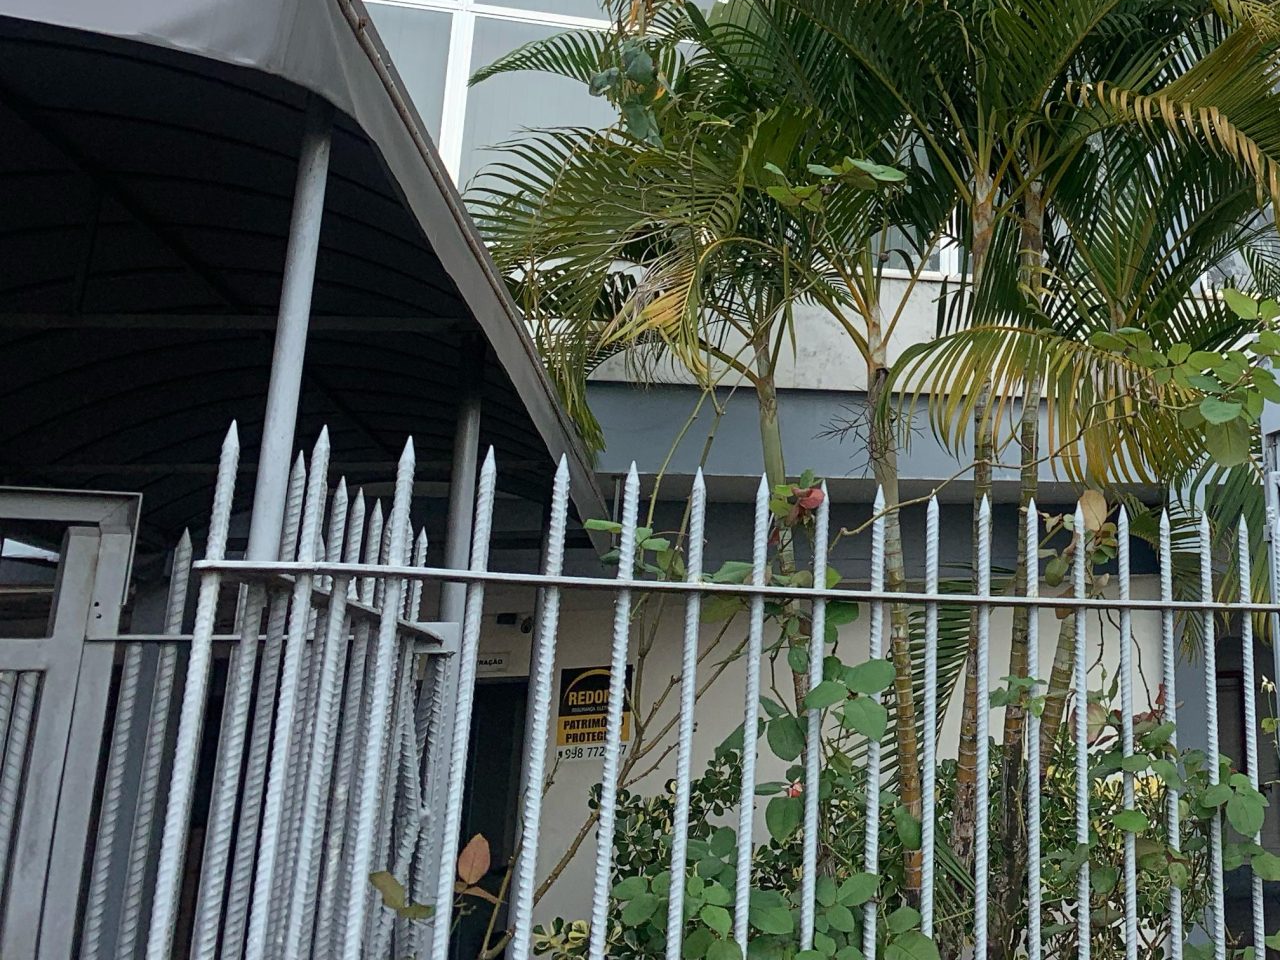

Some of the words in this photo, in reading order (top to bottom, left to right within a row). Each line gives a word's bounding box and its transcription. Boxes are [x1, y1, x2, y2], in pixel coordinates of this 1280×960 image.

[568, 689, 611, 706] REDO
[563, 715, 625, 730] PATRIMÔ
[565, 730, 609, 743] PROTEGI
